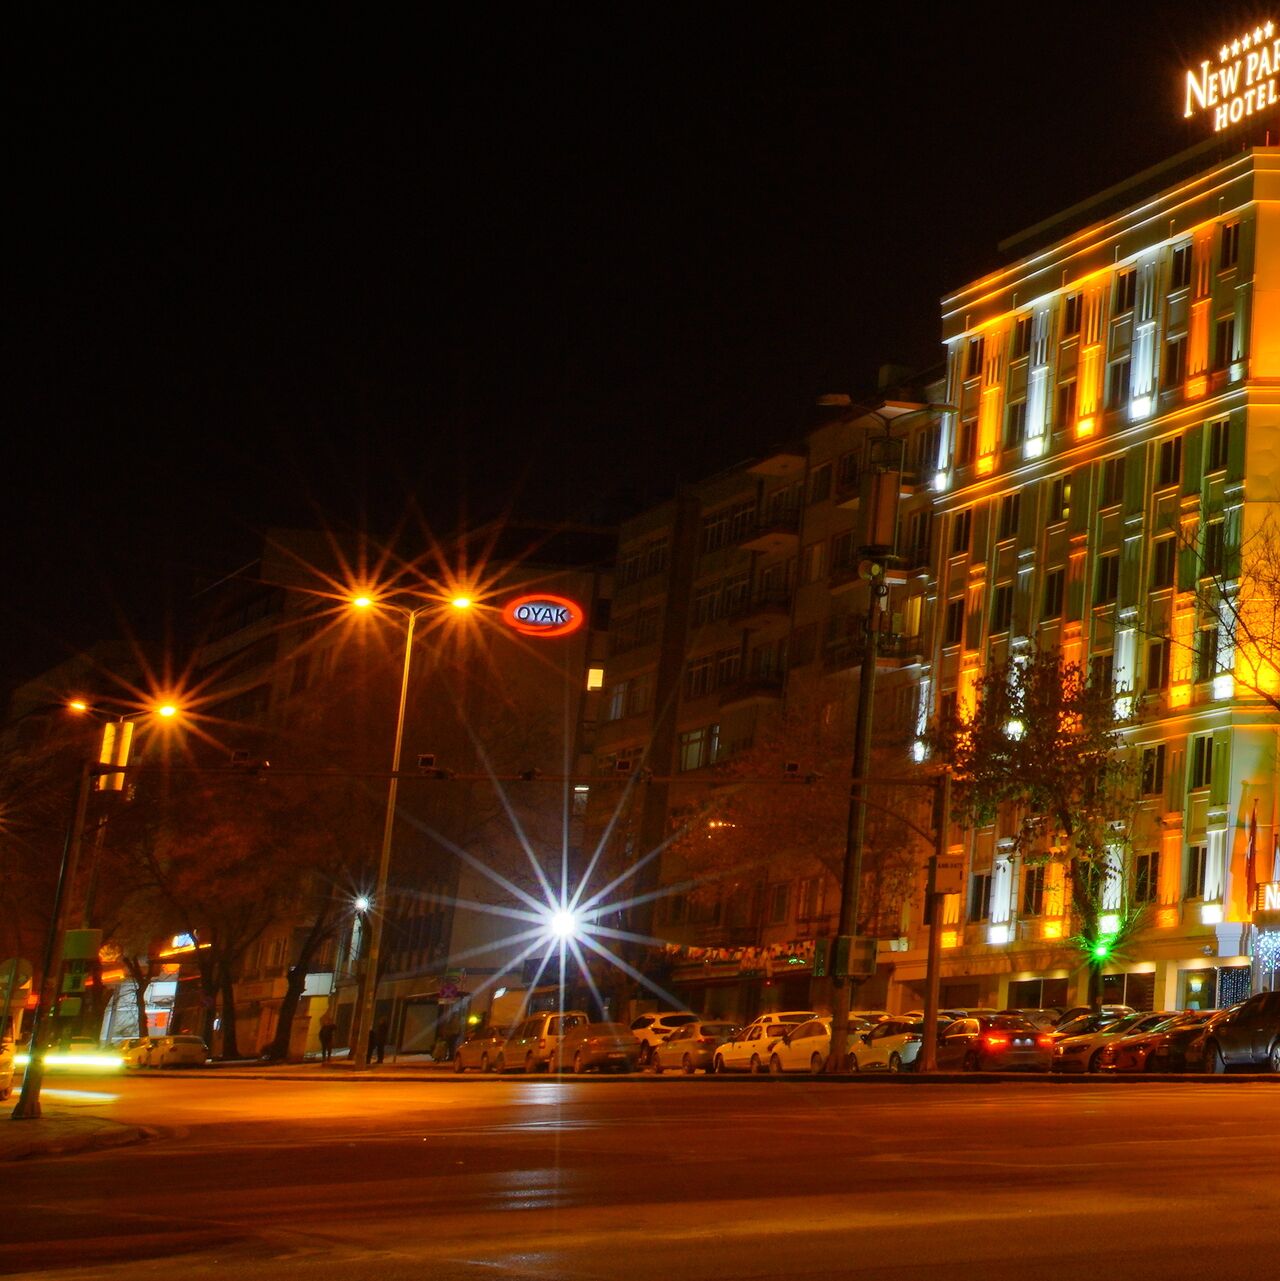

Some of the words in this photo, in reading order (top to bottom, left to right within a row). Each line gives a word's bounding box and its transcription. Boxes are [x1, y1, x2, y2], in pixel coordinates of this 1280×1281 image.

[1184, 60, 1241, 118] NEW
[1215, 79, 1278, 132] HOTEL
[517, 606, 567, 623] OYAK
